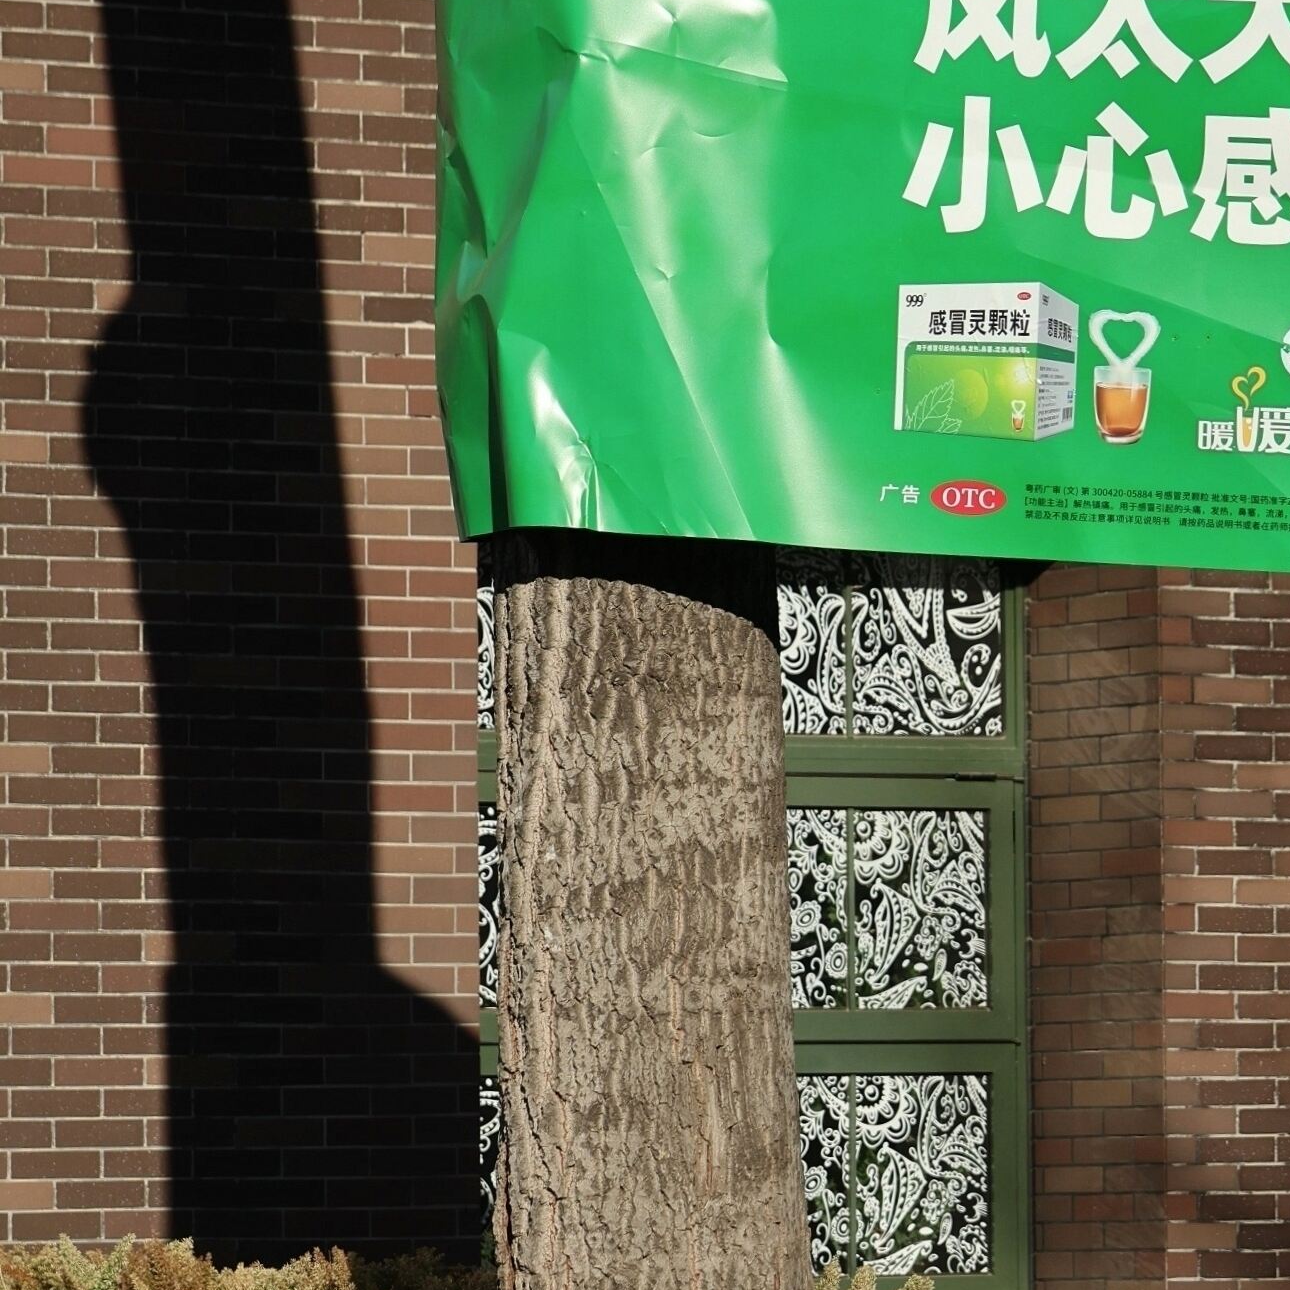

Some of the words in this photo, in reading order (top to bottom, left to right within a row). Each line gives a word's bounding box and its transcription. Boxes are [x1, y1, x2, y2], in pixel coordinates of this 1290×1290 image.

[905, 294, 924, 307] 999
[928, 309, 1031, 337] 感冒灵颗粒
[879, 483, 921, 505] 广告
[942, 486, 996, 510] OTC
